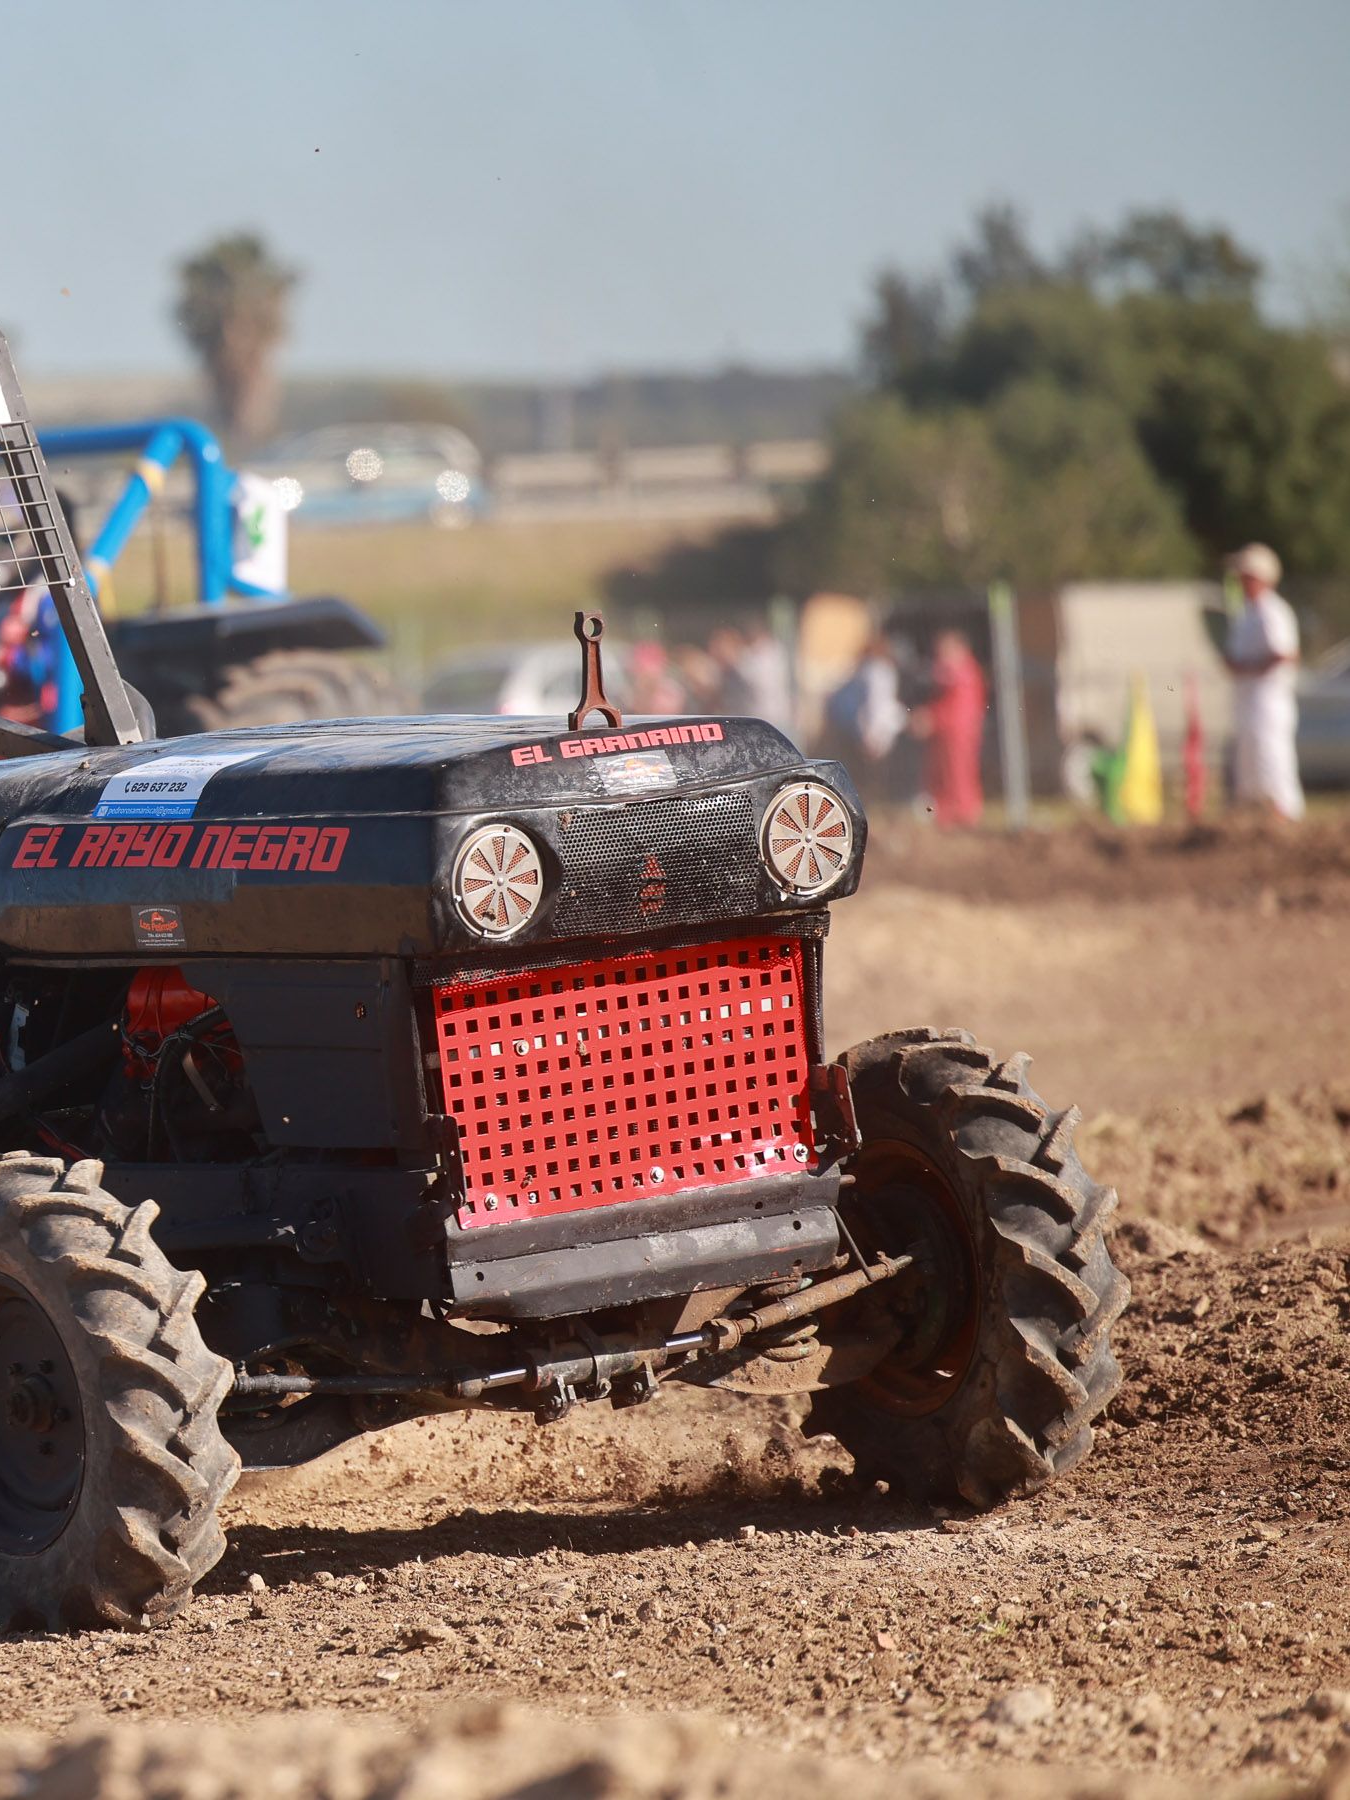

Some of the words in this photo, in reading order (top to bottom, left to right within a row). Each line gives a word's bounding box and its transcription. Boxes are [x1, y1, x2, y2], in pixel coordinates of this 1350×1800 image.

[511, 745, 553, 767] EL
[559, 723, 724, 759] GRANAINO
[131, 782, 148, 793] 629
[149, 782, 169, 793] 637
[167, 782, 188, 792] 232
[12, 826, 64, 869] EL
[68, 825, 194, 869] RAYO
[189, 826, 350, 872] NEGRO
